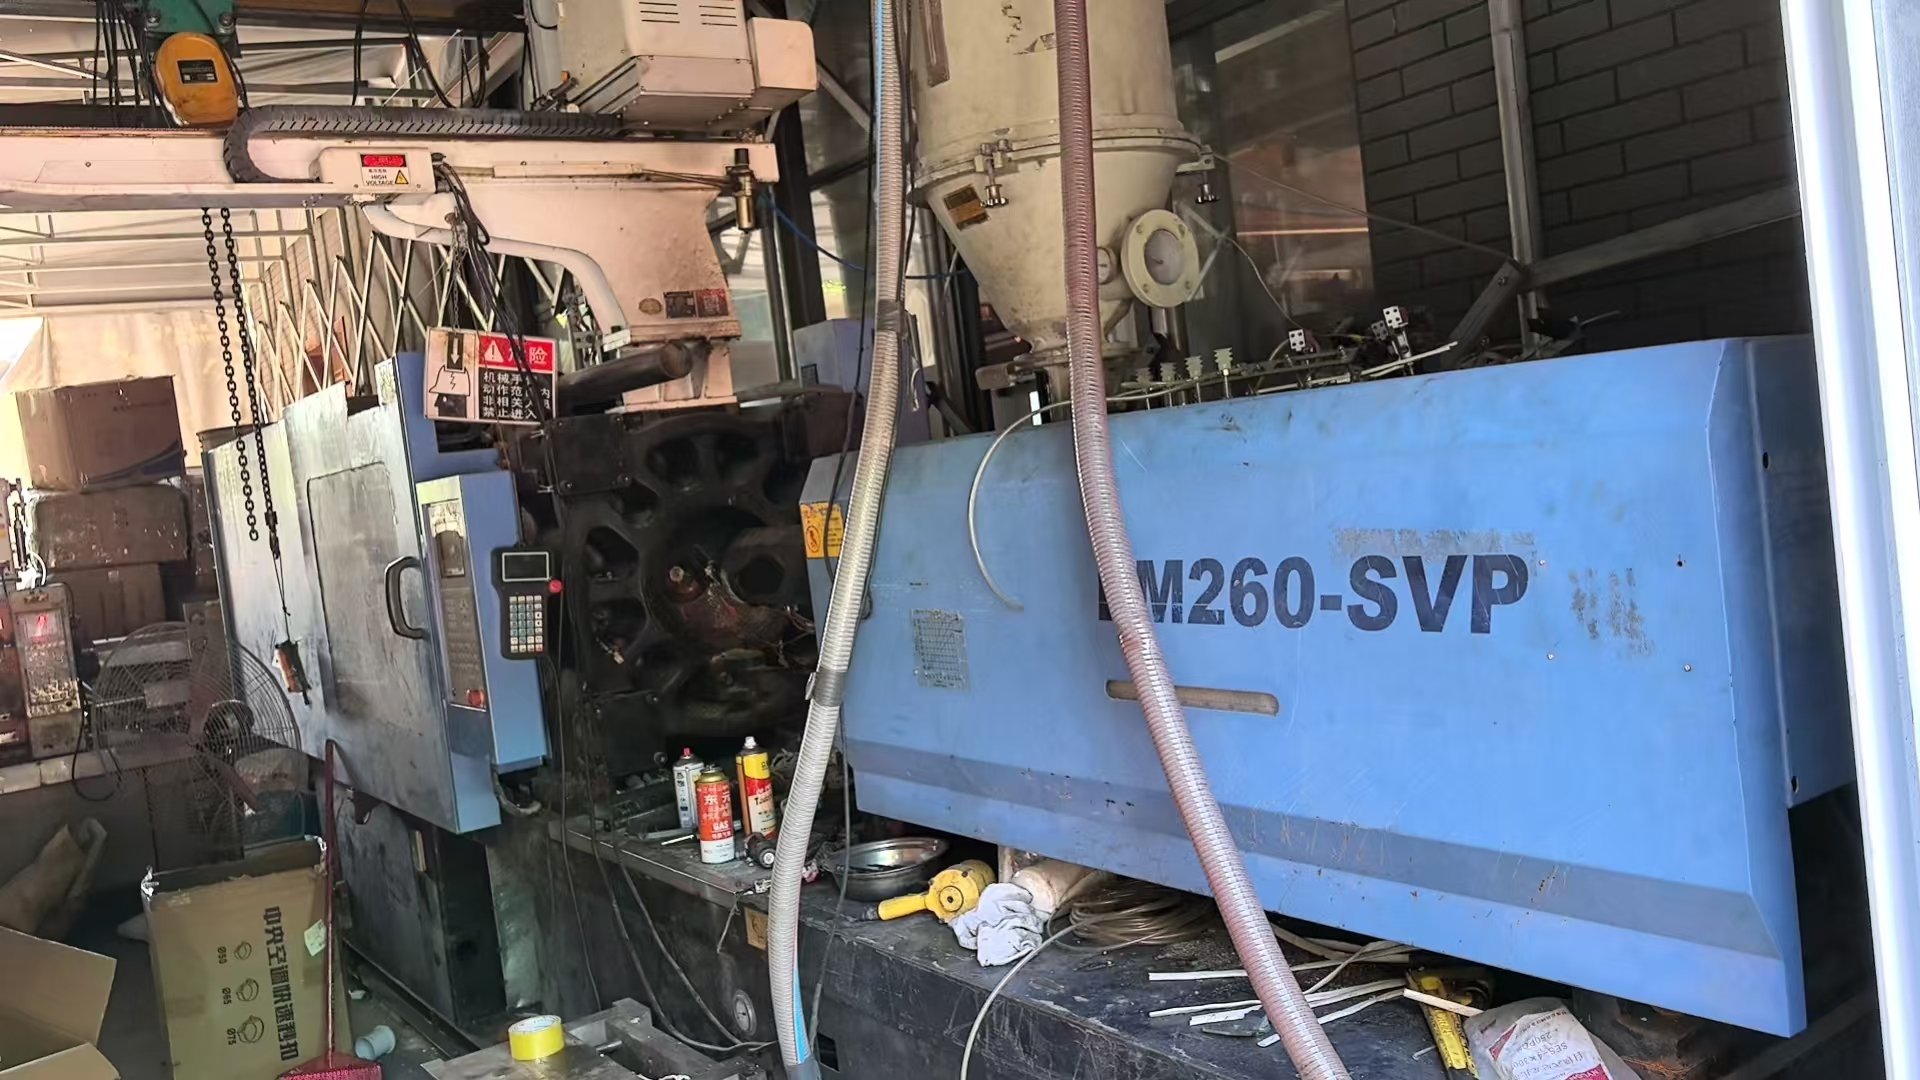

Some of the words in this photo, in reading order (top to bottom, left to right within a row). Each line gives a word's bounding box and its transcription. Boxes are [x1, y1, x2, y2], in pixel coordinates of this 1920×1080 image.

[483, 371, 537, 386] 机械手
[483, 384, 550, 399] 动作范内
[483, 407, 537, 420] 禁止进入
[1099, 555, 1529, 634] M260-SVP
[713, 820, 729, 831] GAS
[263, 905, 299, 1062] 中央空调快速秒扣
